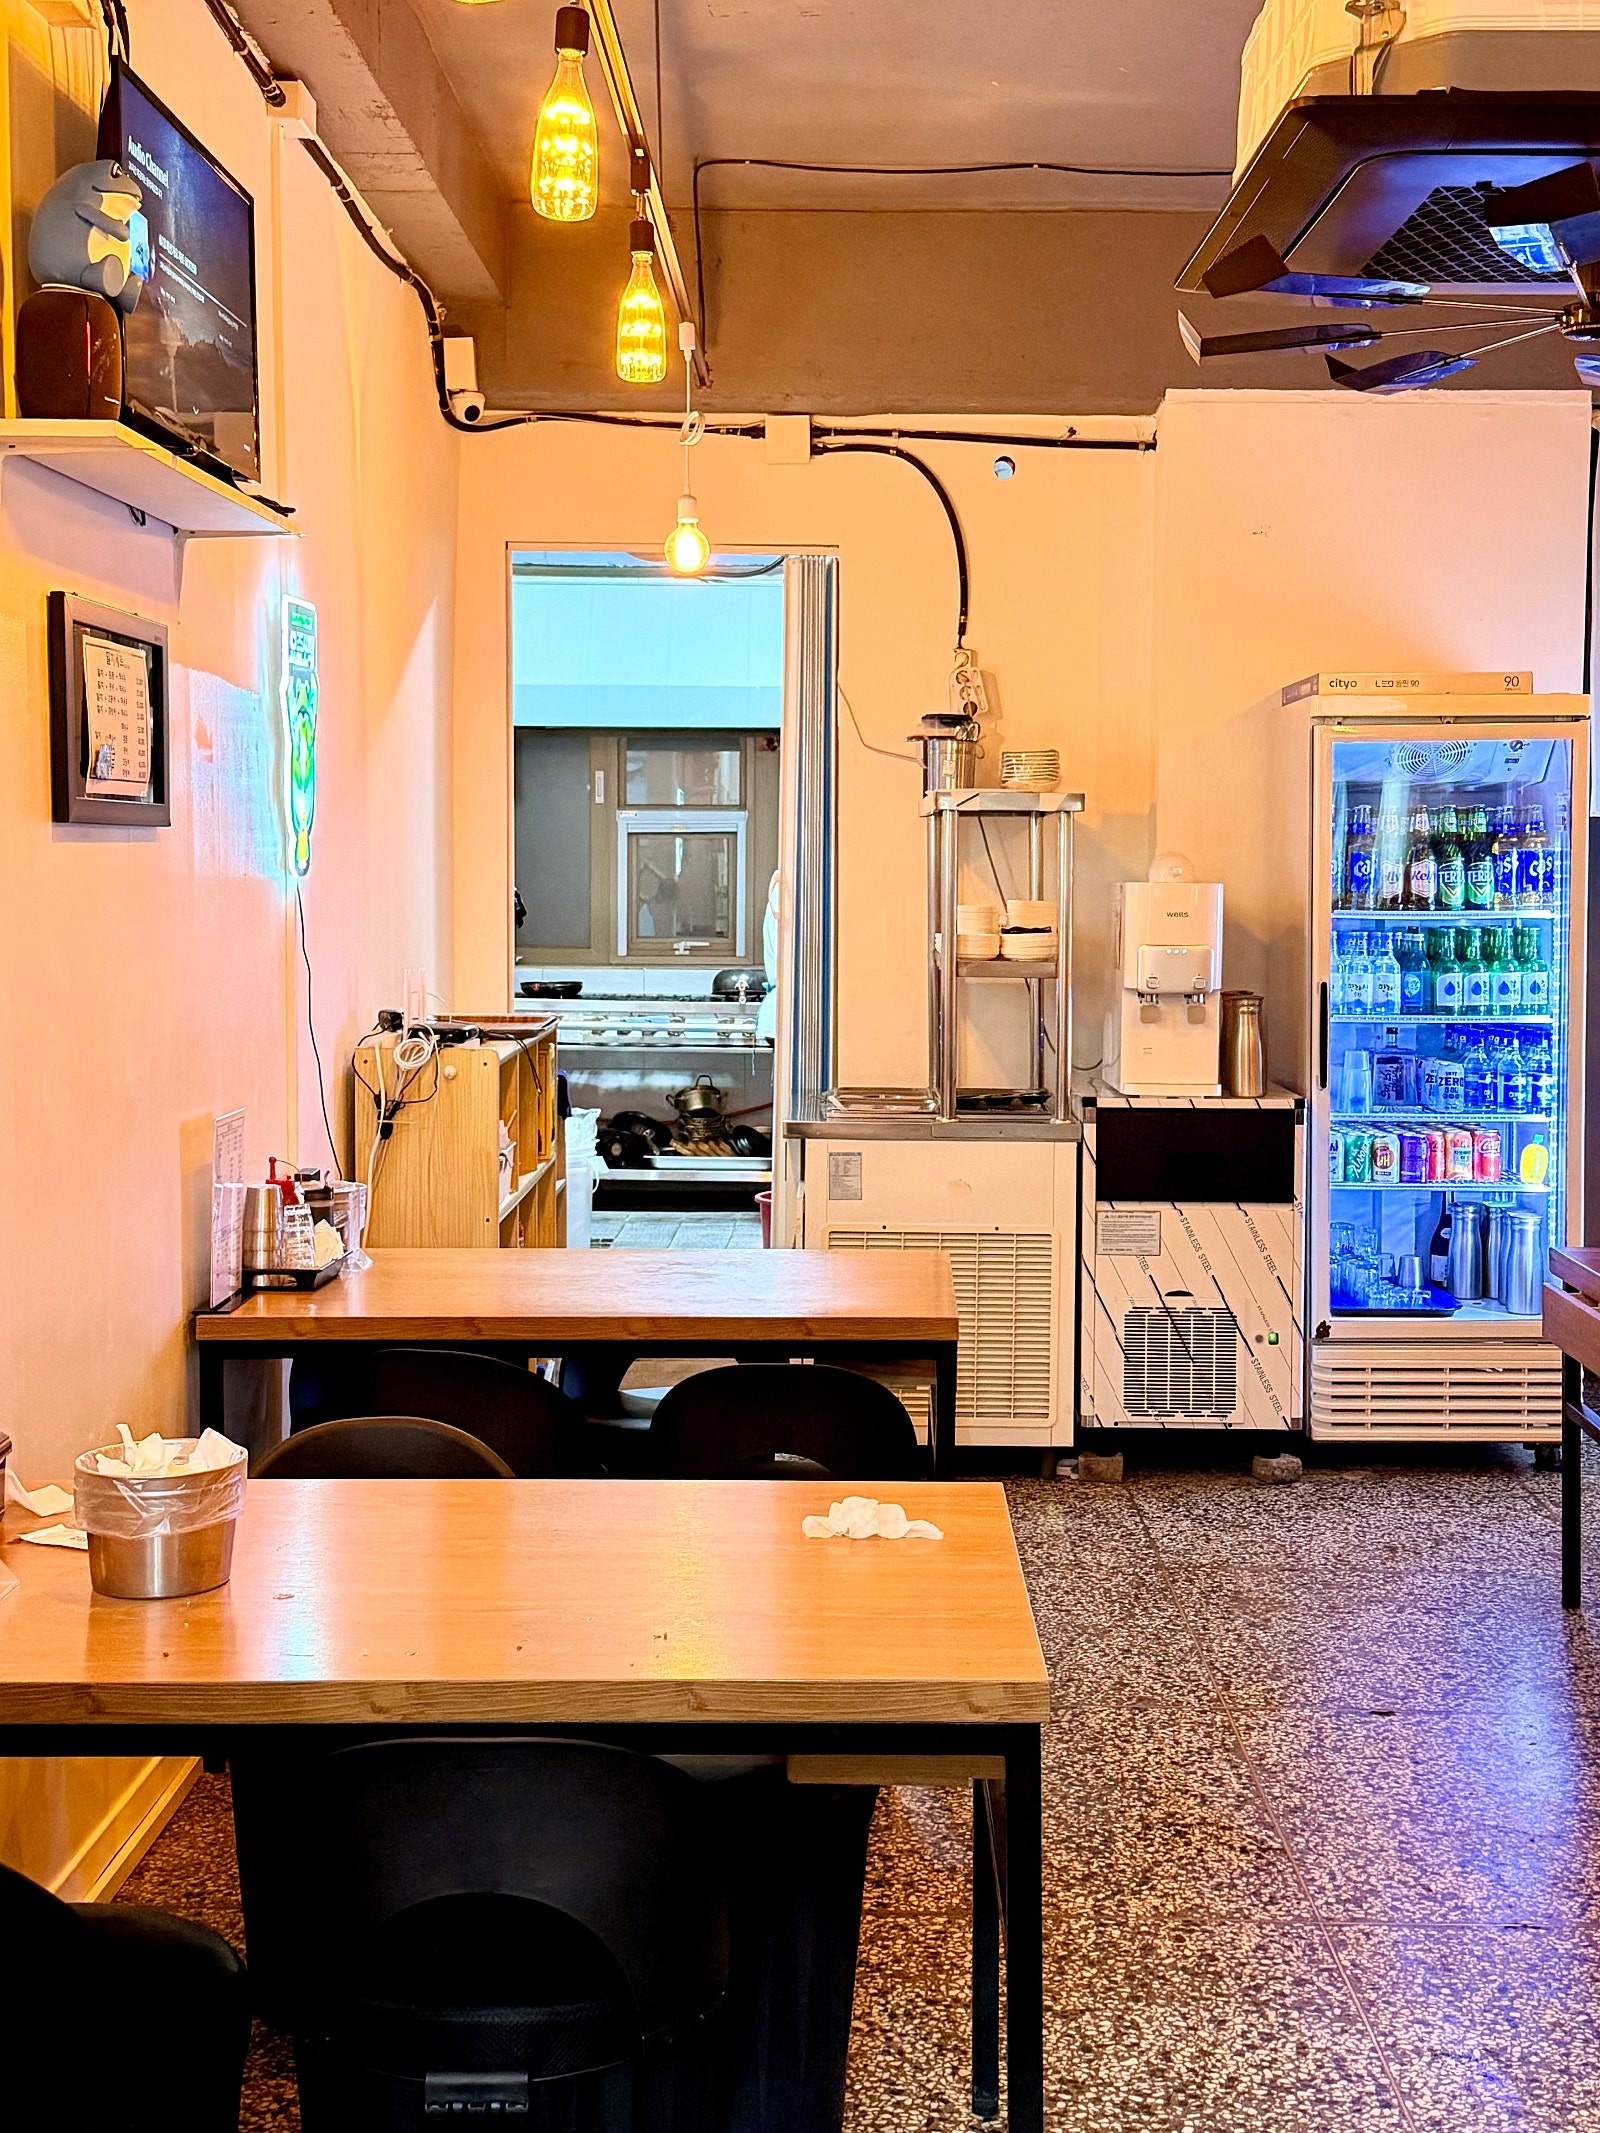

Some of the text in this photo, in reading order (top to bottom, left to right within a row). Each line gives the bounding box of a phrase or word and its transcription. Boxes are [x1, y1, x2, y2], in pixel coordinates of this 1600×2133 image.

[128, 135, 145, 166] Audio
[146, 152, 169, 189] Channel
[1329, 678, 1357, 690] cityo
[1504, 675, 1520, 687] 90
[1180, 1216, 1213, 1274] STAINLESS STEEL
[1245, 1217, 1277, 1275] STAINLESS STEEL
[1251, 1357, 1283, 1415] STAINLESS STEEL
